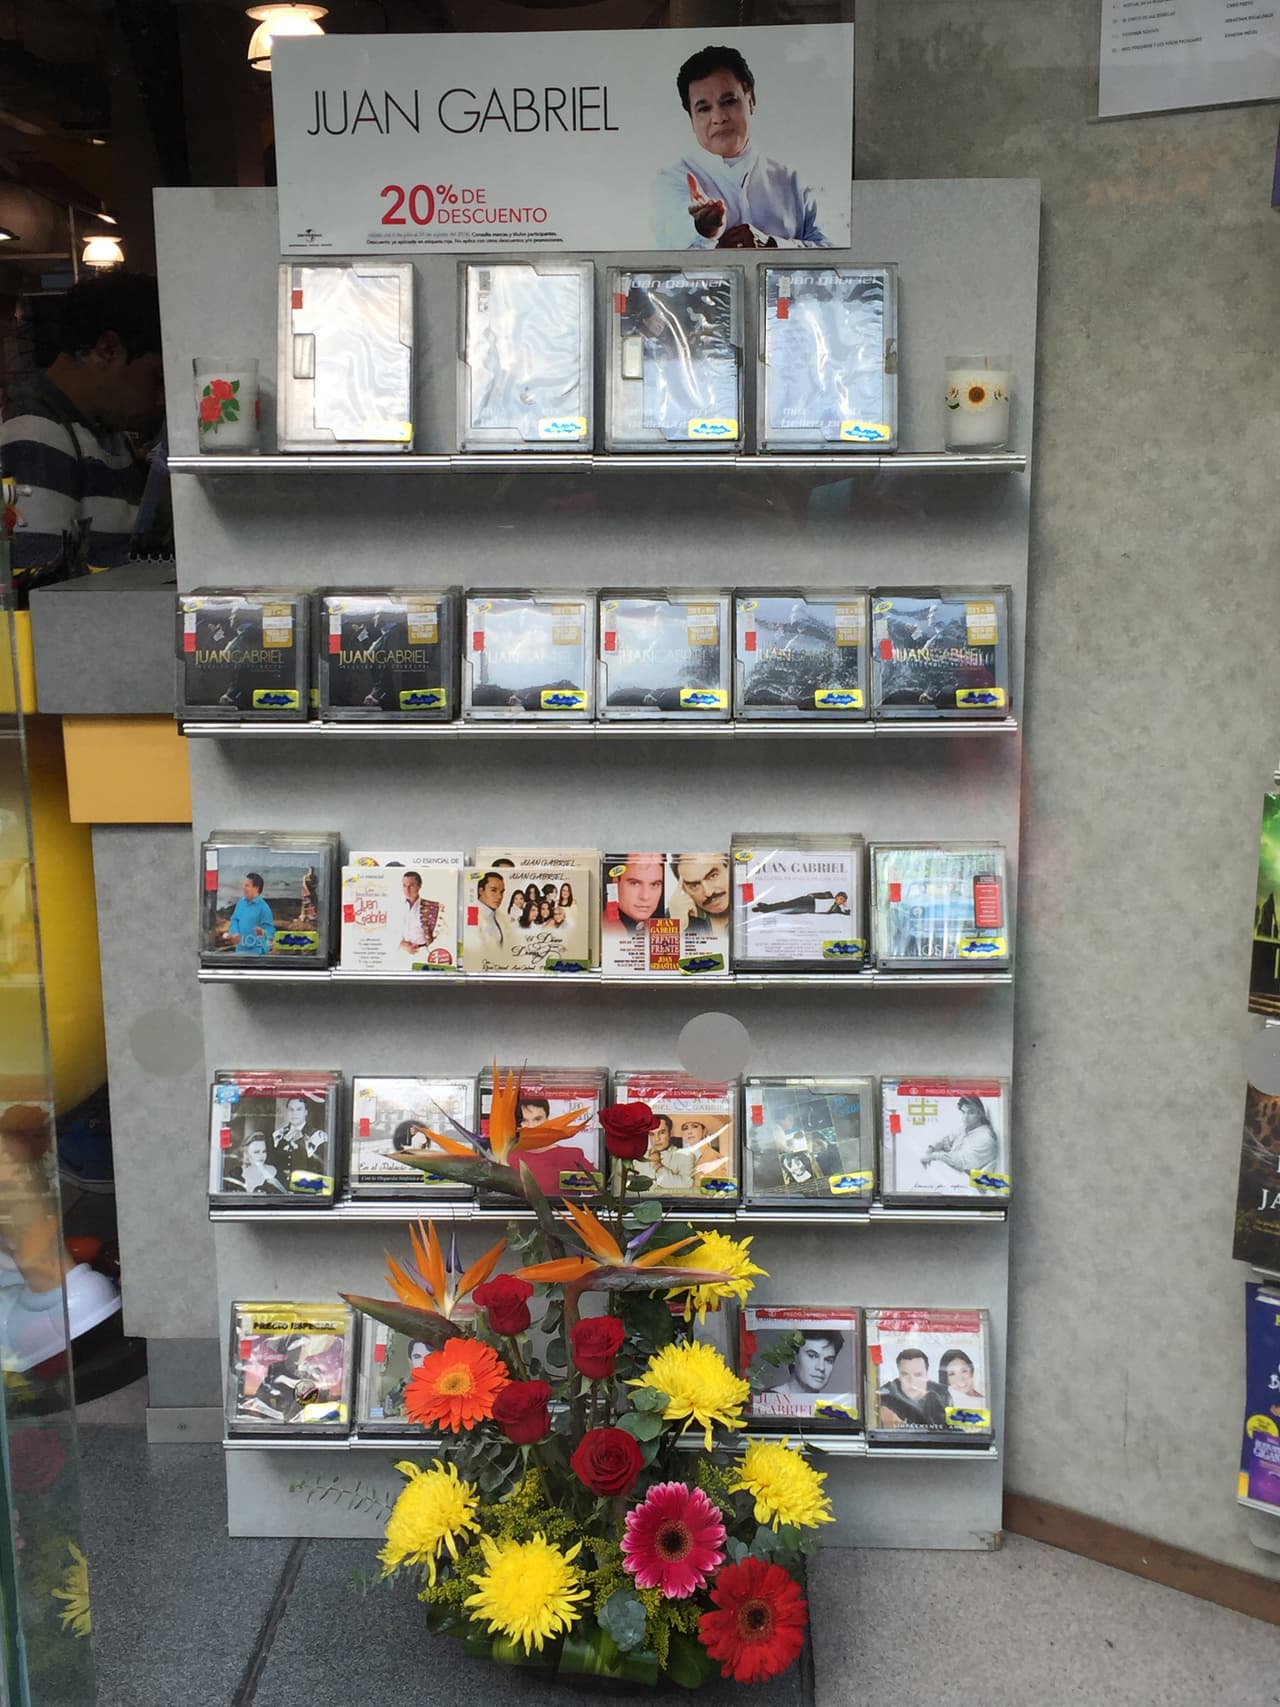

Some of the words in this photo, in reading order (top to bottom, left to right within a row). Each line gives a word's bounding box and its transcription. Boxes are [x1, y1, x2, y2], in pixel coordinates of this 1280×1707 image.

[306, 89, 420, 136] JUAN
[438, 86, 619, 134] GABRIEL
[380, 184, 458, 226] 20%
[461, 188, 486, 204] DE
[437, 207, 548, 225] DESCUENTO
[450, 857, 459, 865] DE
[791, 862, 849, 873] GABRIEL
[650, 934, 680, 945] FRENTE
[650, 944, 680, 954] FRENTE
[253, 1322, 289, 1330] PRECIO
